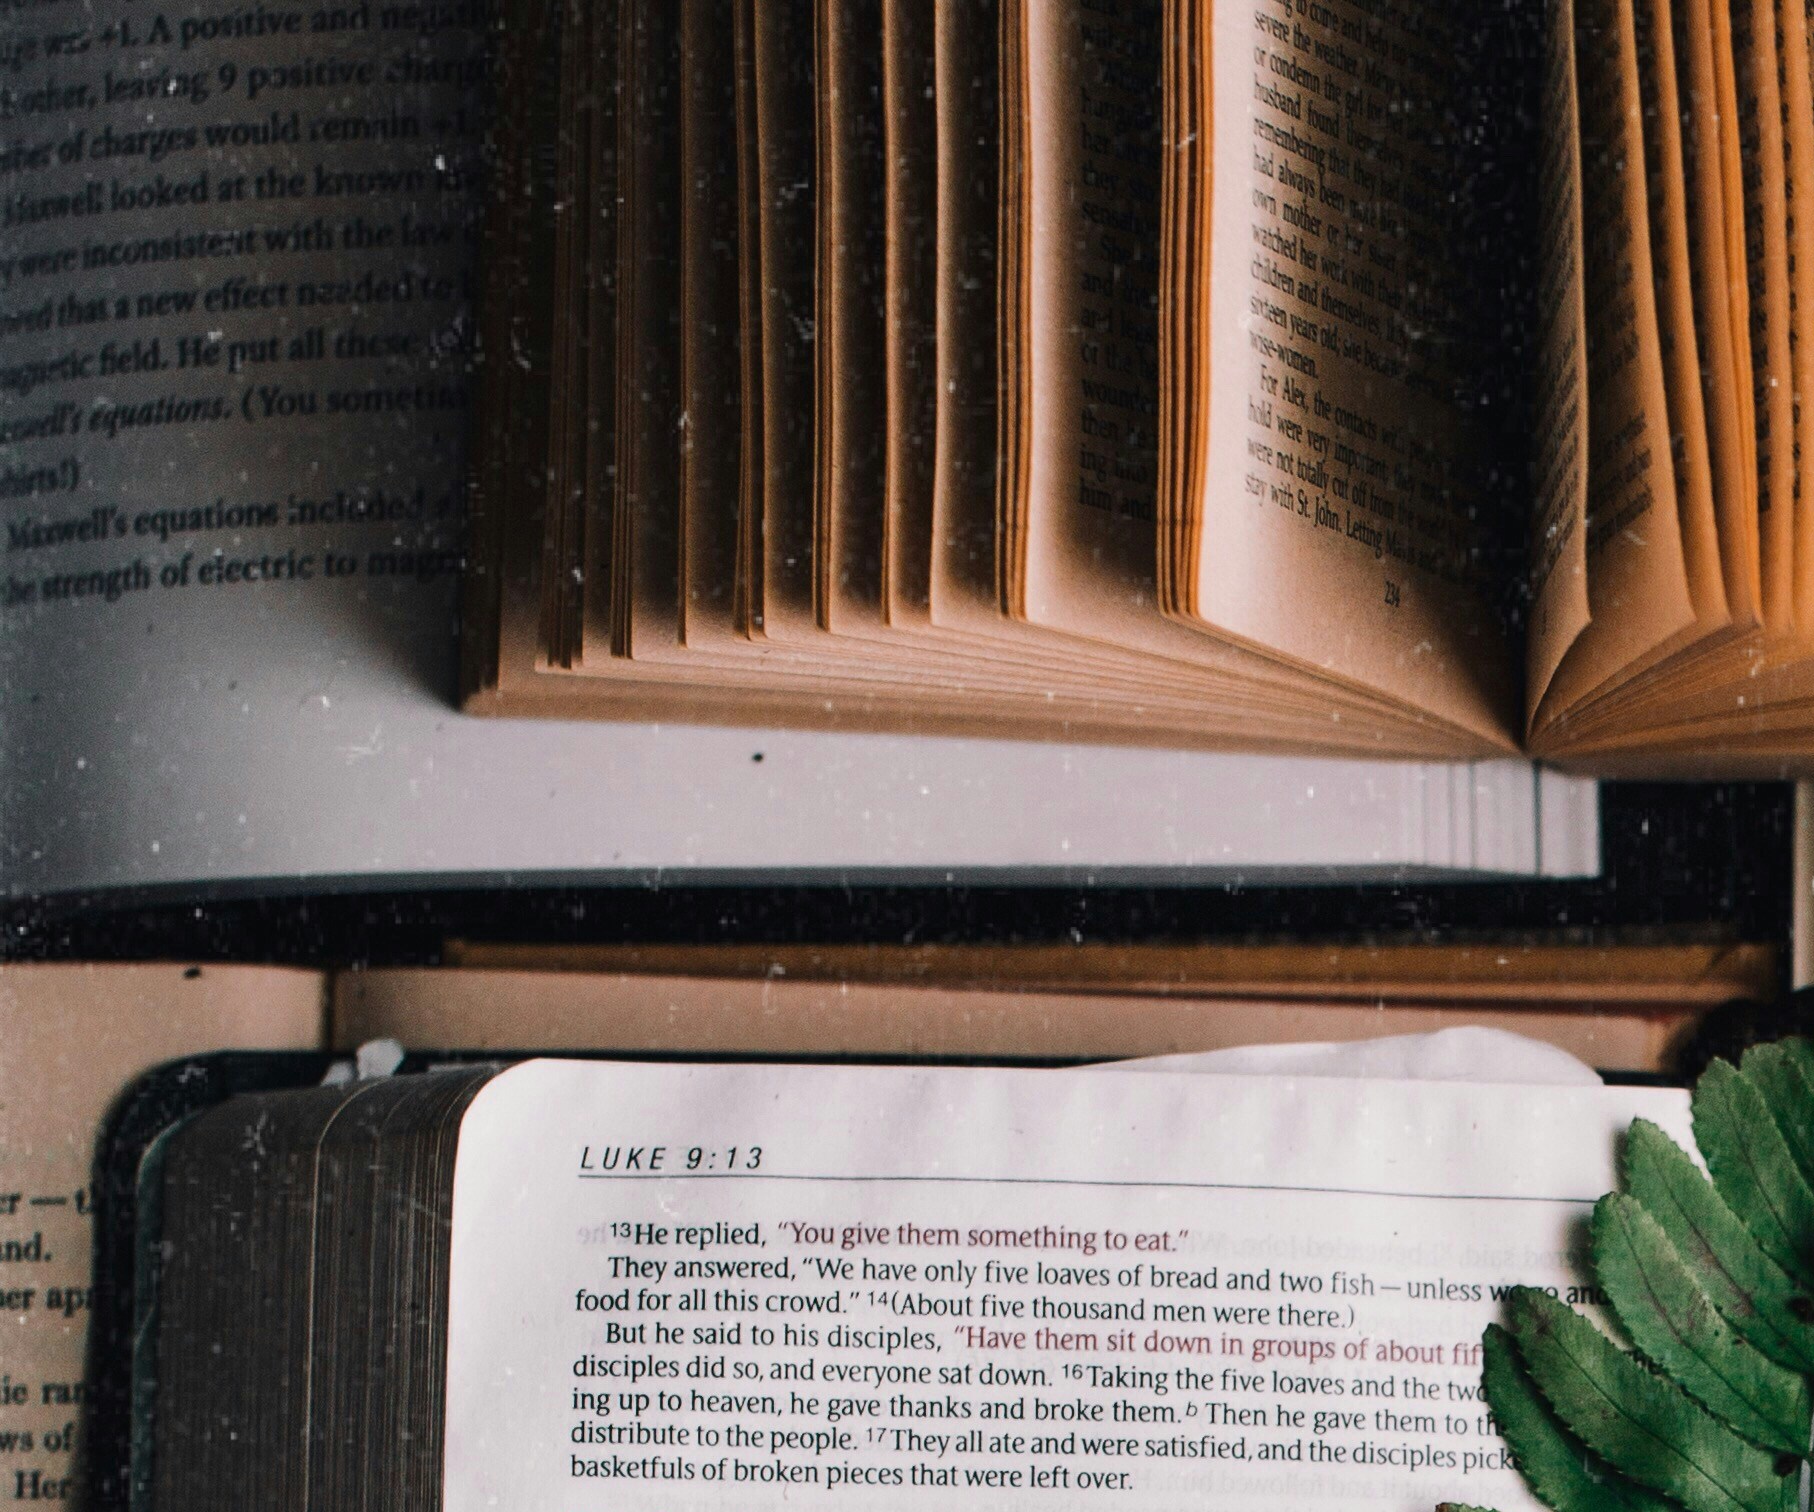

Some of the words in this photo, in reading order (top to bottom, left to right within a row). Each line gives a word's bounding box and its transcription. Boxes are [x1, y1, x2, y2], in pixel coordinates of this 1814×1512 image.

[580, 1147, 666, 1176] LUKE
[686, 1147, 762, 1176] 9:13
[571, 1454, 695, 1479] basketfuls
[702, 1458, 727, 1480] of
[735, 1459, 818, 1483] broken
[827, 1461, 903, 1489] pieces
[911, 1463, 957, 1486] that
[965, 1470, 1022, 1487] were
[1031, 1465, 1069, 1488] left
[1077, 1472, 1132, 1489] over.
